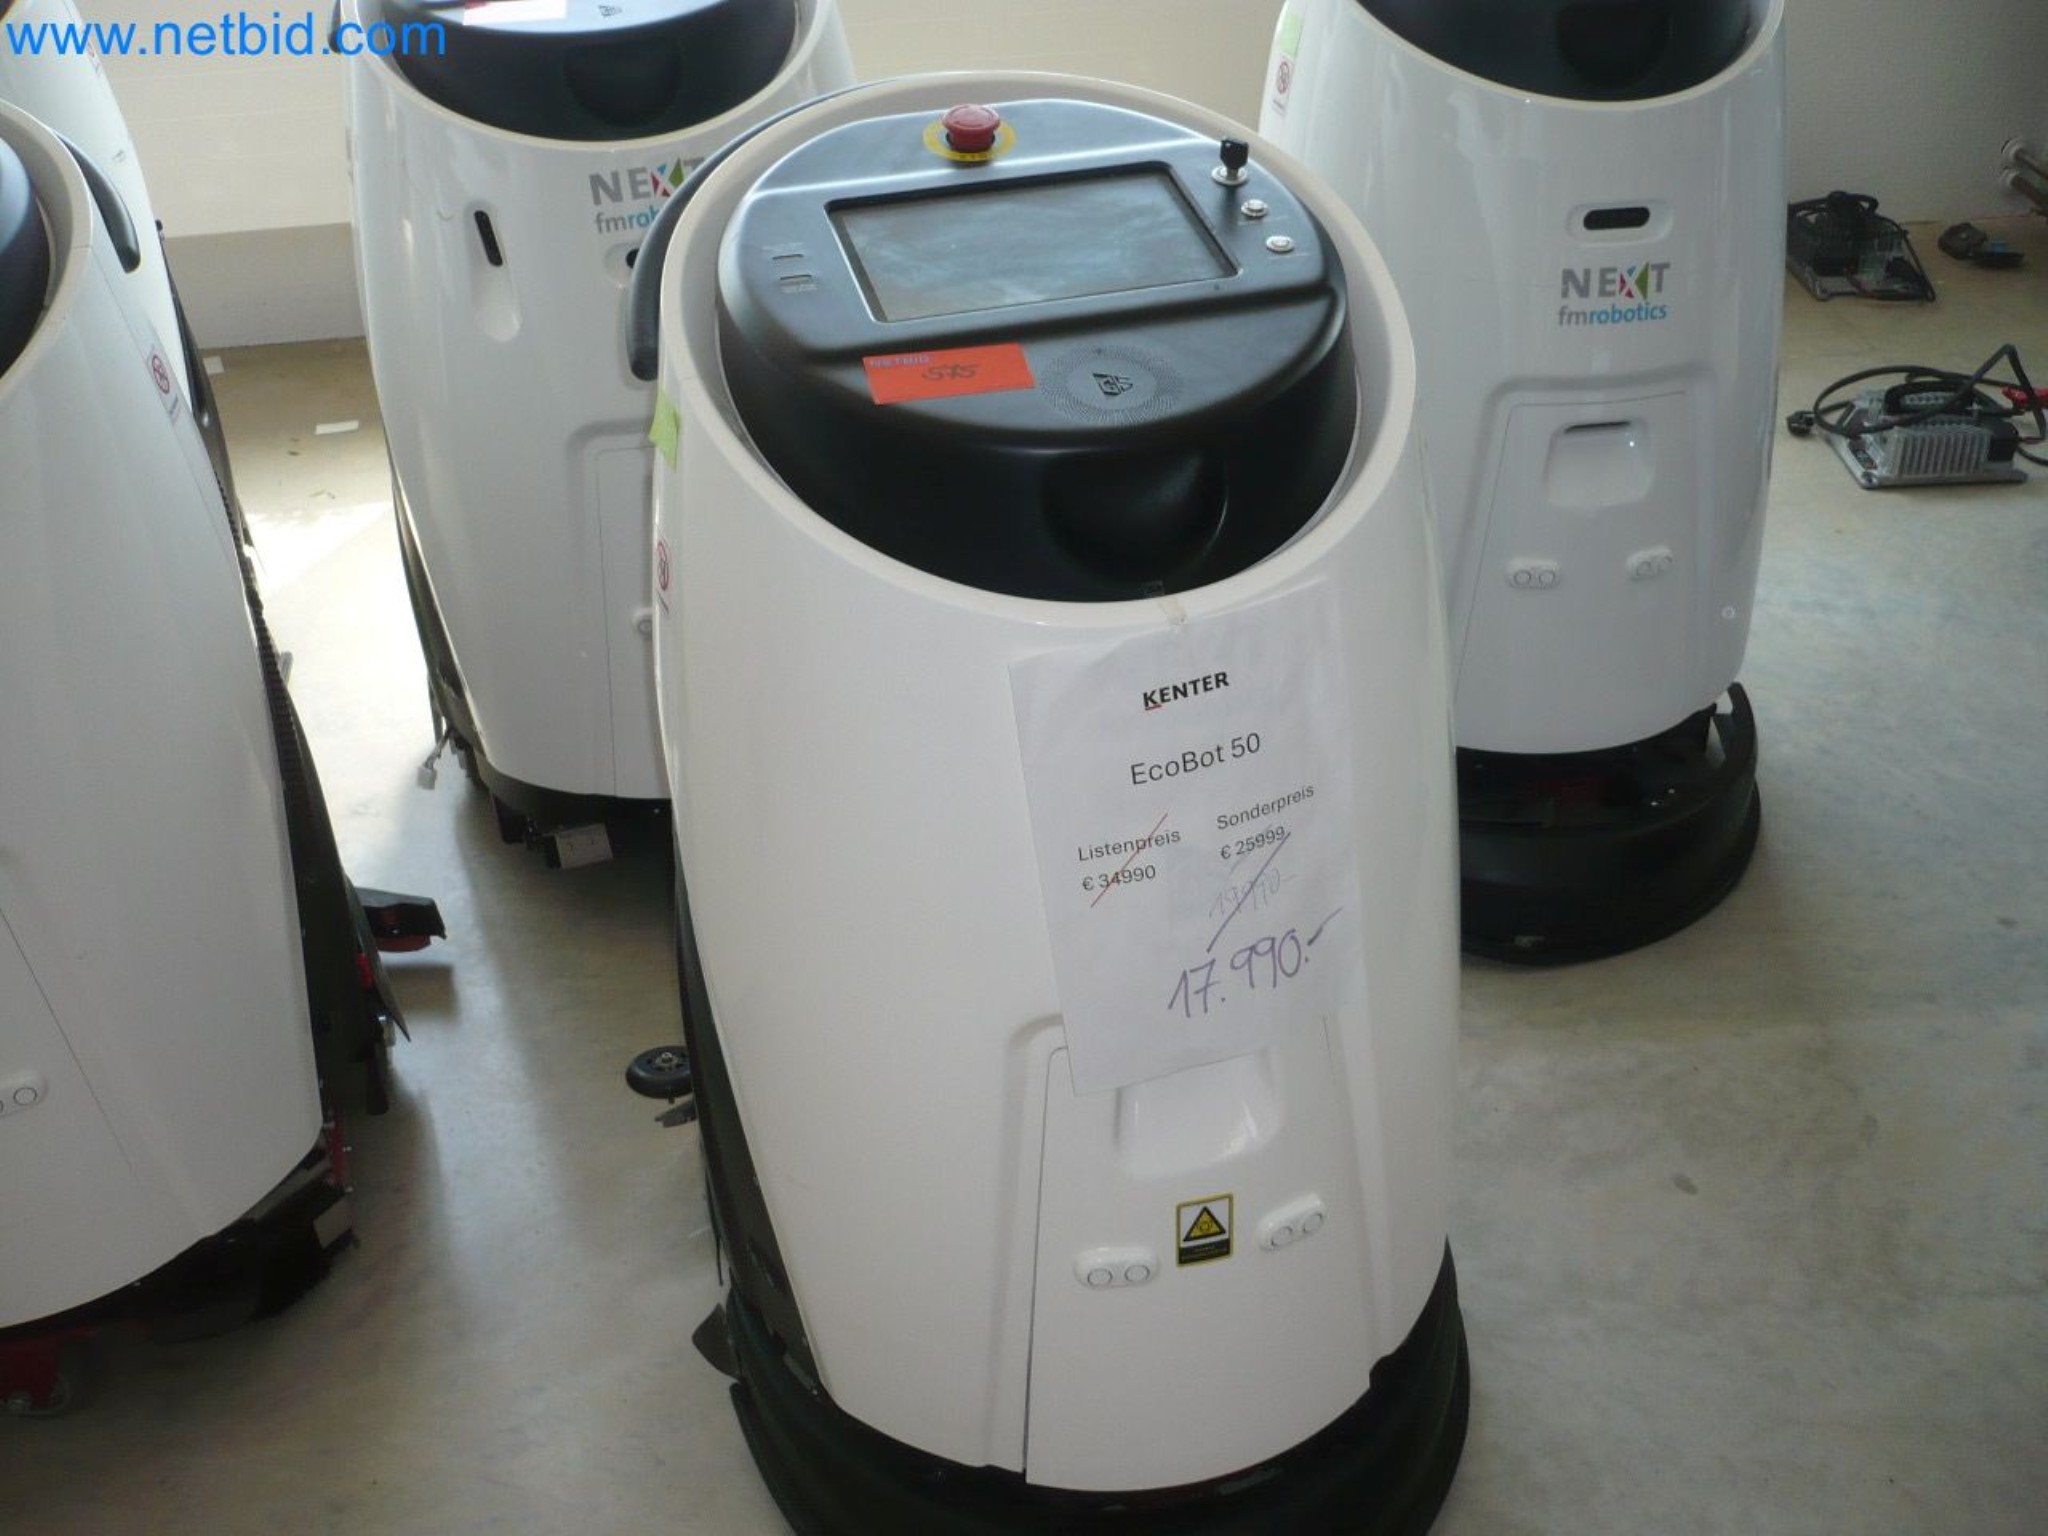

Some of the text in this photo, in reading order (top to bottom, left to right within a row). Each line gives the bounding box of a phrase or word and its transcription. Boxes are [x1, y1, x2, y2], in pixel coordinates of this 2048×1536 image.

[1561, 261, 1671, 301] NEXT
[1558, 302, 1668, 327] fmrobotics
[1142, 671, 1230, 710] KENTER
[1130, 732, 1261, 785] EcoBot 50
[1217, 784, 1315, 830] Sonderpreis
[1077, 830, 1182, 862] Listenpreis
[1220, 826, 1287, 860] € 25999
[1082, 864, 1157, 891] € 34990
